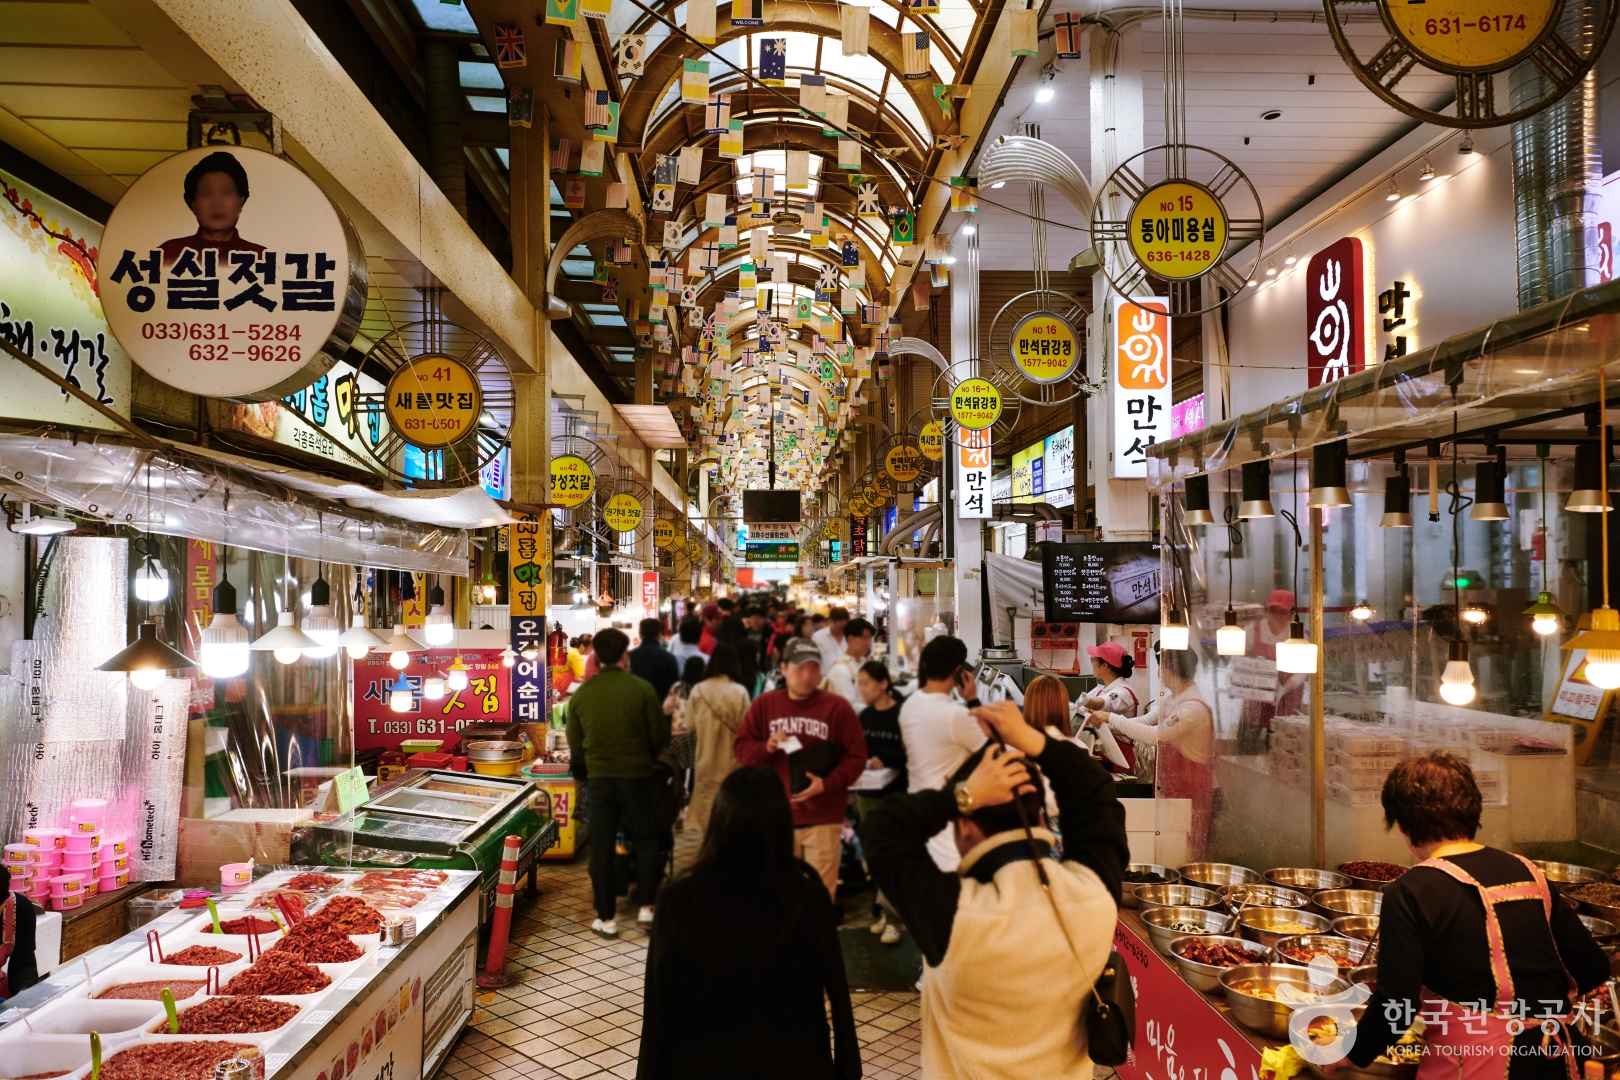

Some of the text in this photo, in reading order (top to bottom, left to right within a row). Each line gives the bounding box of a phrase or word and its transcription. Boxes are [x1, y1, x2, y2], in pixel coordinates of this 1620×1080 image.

[1424, 14, 1527, 35] 631-6174
[1160, 195, 1193, 212] NO 15
[1141, 217, 1215, 243] 동아미용실
[1147, 250, 1211, 262] 636-1428
[110, 249, 336, 313] 성실젓갈
[141, 321, 302, 342] 033)631-5284
[1032, 324, 1057, 335] NO 16
[189, 344, 301, 362] 632-9626
[1020, 338, 1072, 356] 만석닭강정
[1023, 358, 1068, 368] 1577-9042
[432, 367, 452, 382] 41
[972, 385, 990, 393] 16-1
[955, 396, 997, 410] 만석닭강정
[404, 418, 462, 430] 631-0501
[964, 470, 987, 514] 만석
[1131, 577, 1152, 600] 만석
[769, 717, 829, 741] STANFORD
